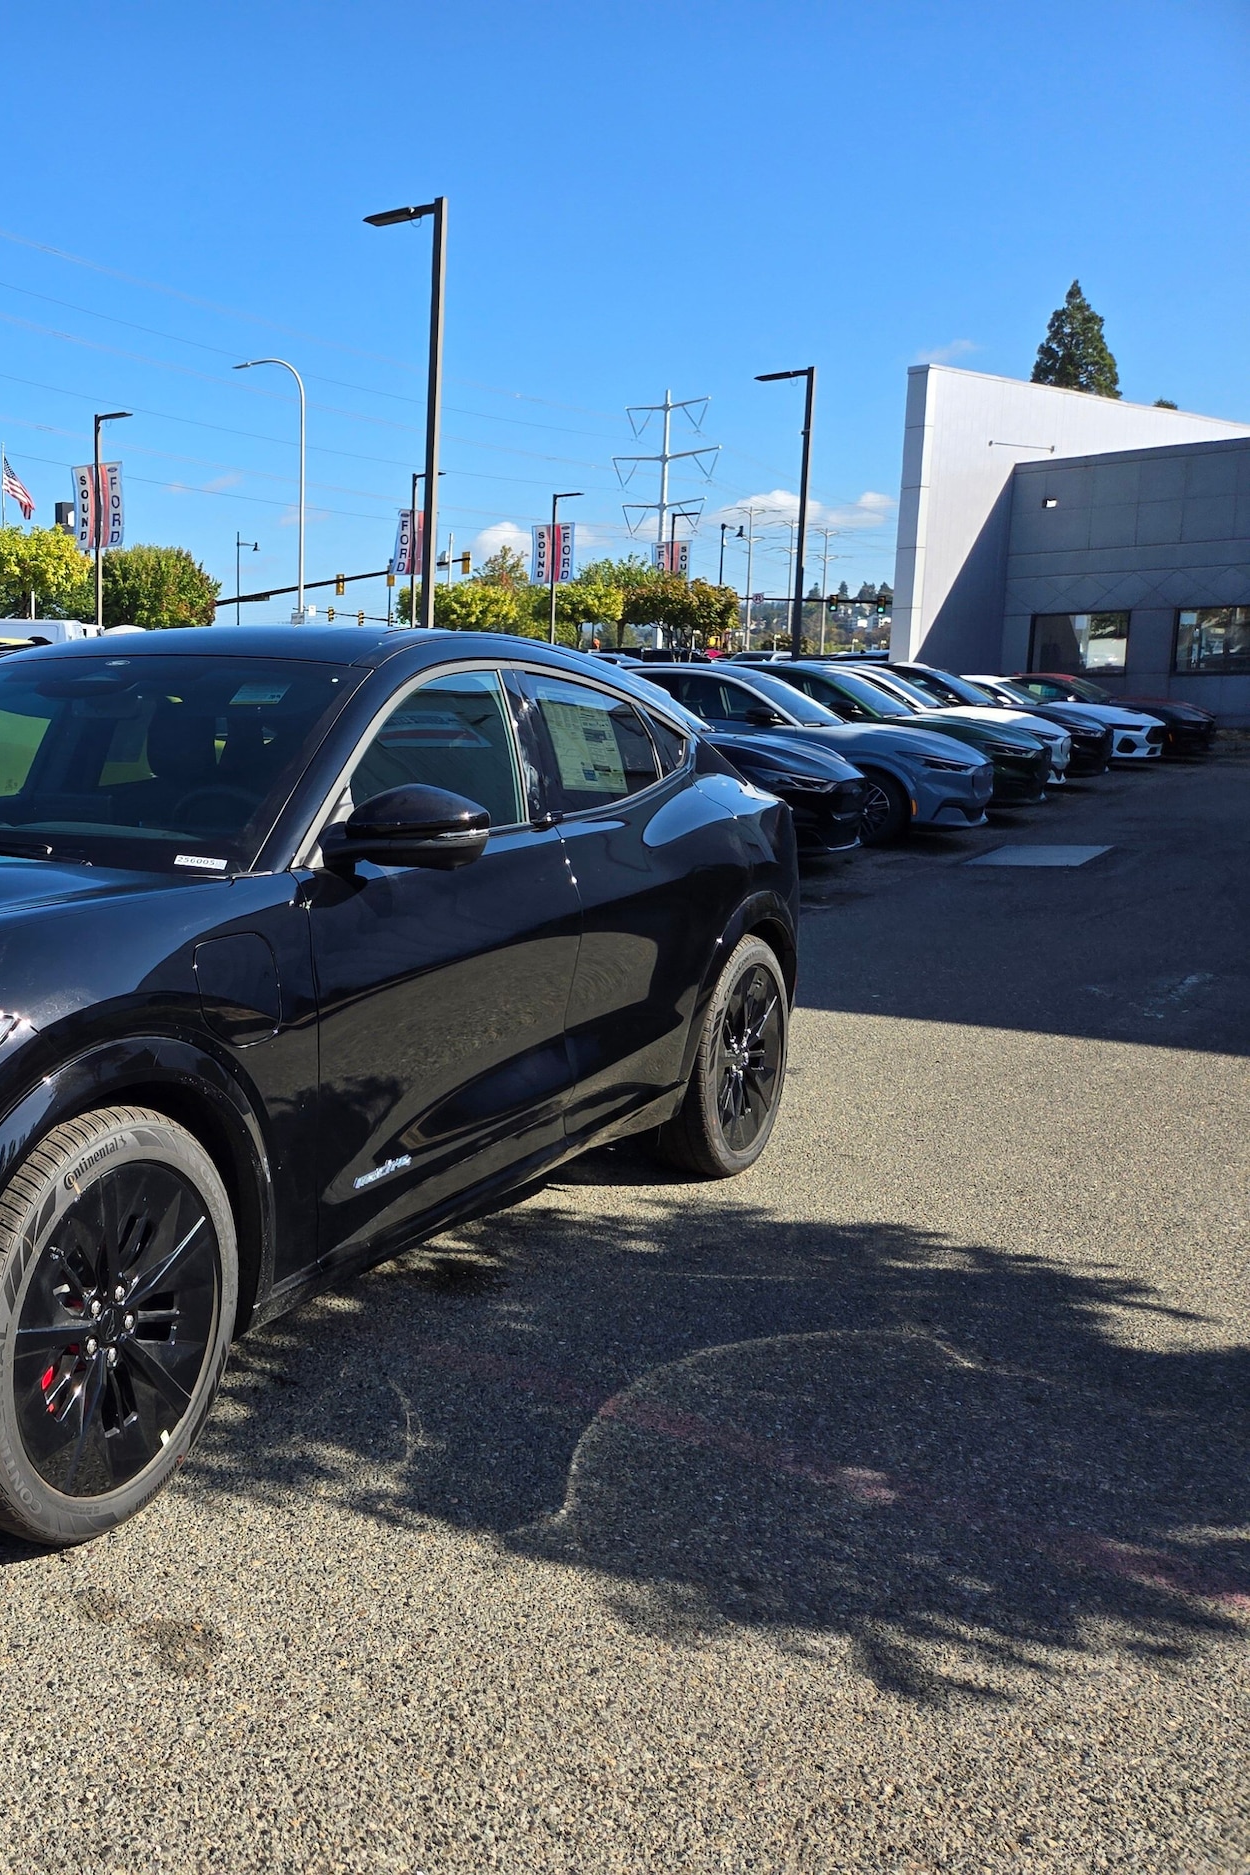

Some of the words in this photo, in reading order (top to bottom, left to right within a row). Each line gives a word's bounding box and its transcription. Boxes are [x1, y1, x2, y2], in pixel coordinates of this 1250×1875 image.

[79, 475, 89, 541] SOUND
[110, 476, 121, 543] FORD
[396, 520, 409, 572] FORD
[537, 531, 546, 578] SOUND
[560, 532, 571, 580] FORD
[63, 1137, 120, 1191] Continental
